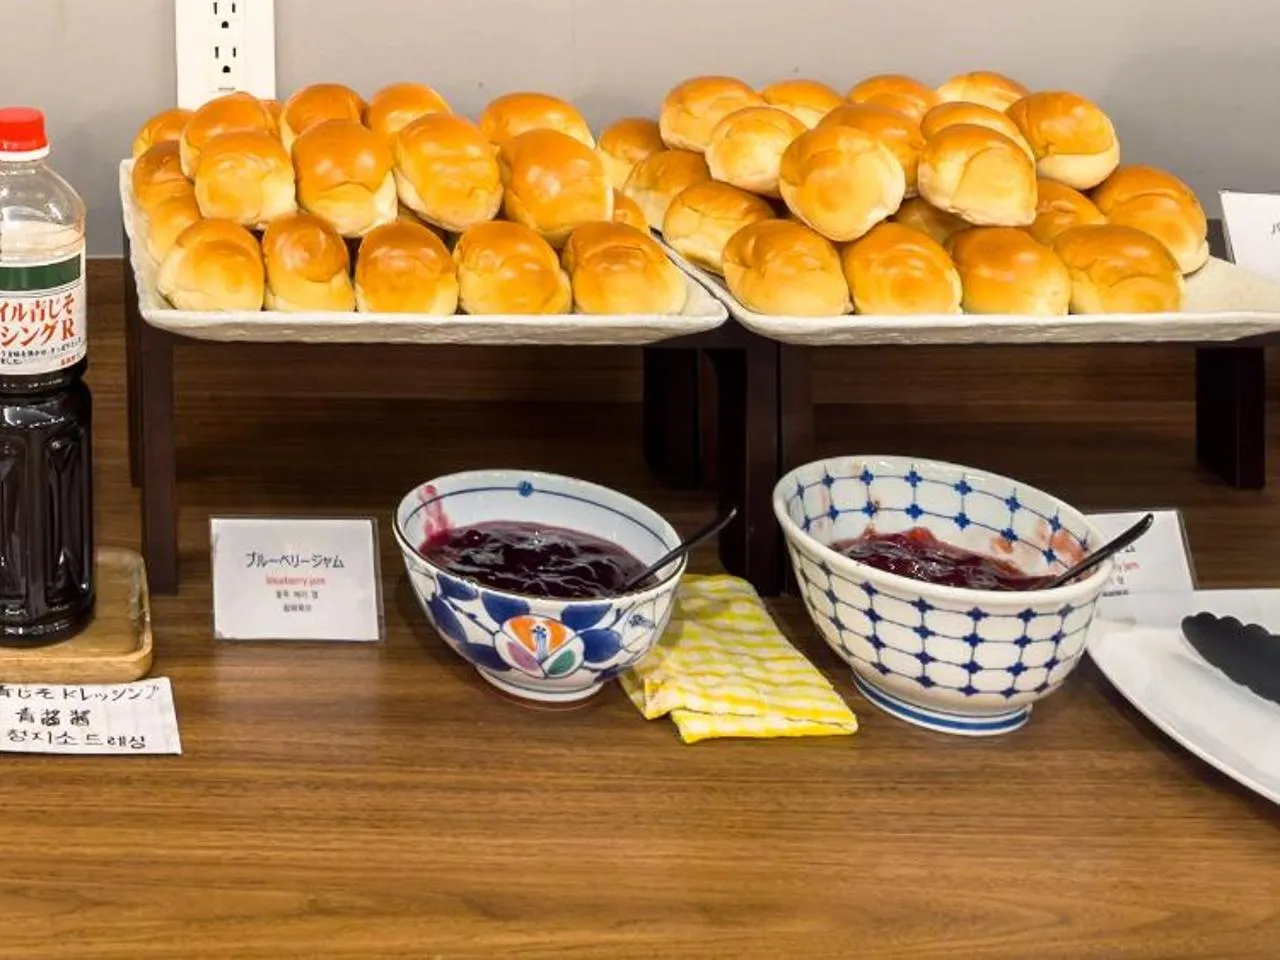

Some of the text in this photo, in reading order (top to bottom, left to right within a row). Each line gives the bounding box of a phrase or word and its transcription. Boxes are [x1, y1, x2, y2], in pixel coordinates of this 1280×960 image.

[246, 551, 345, 568] ブルーベリージャム
